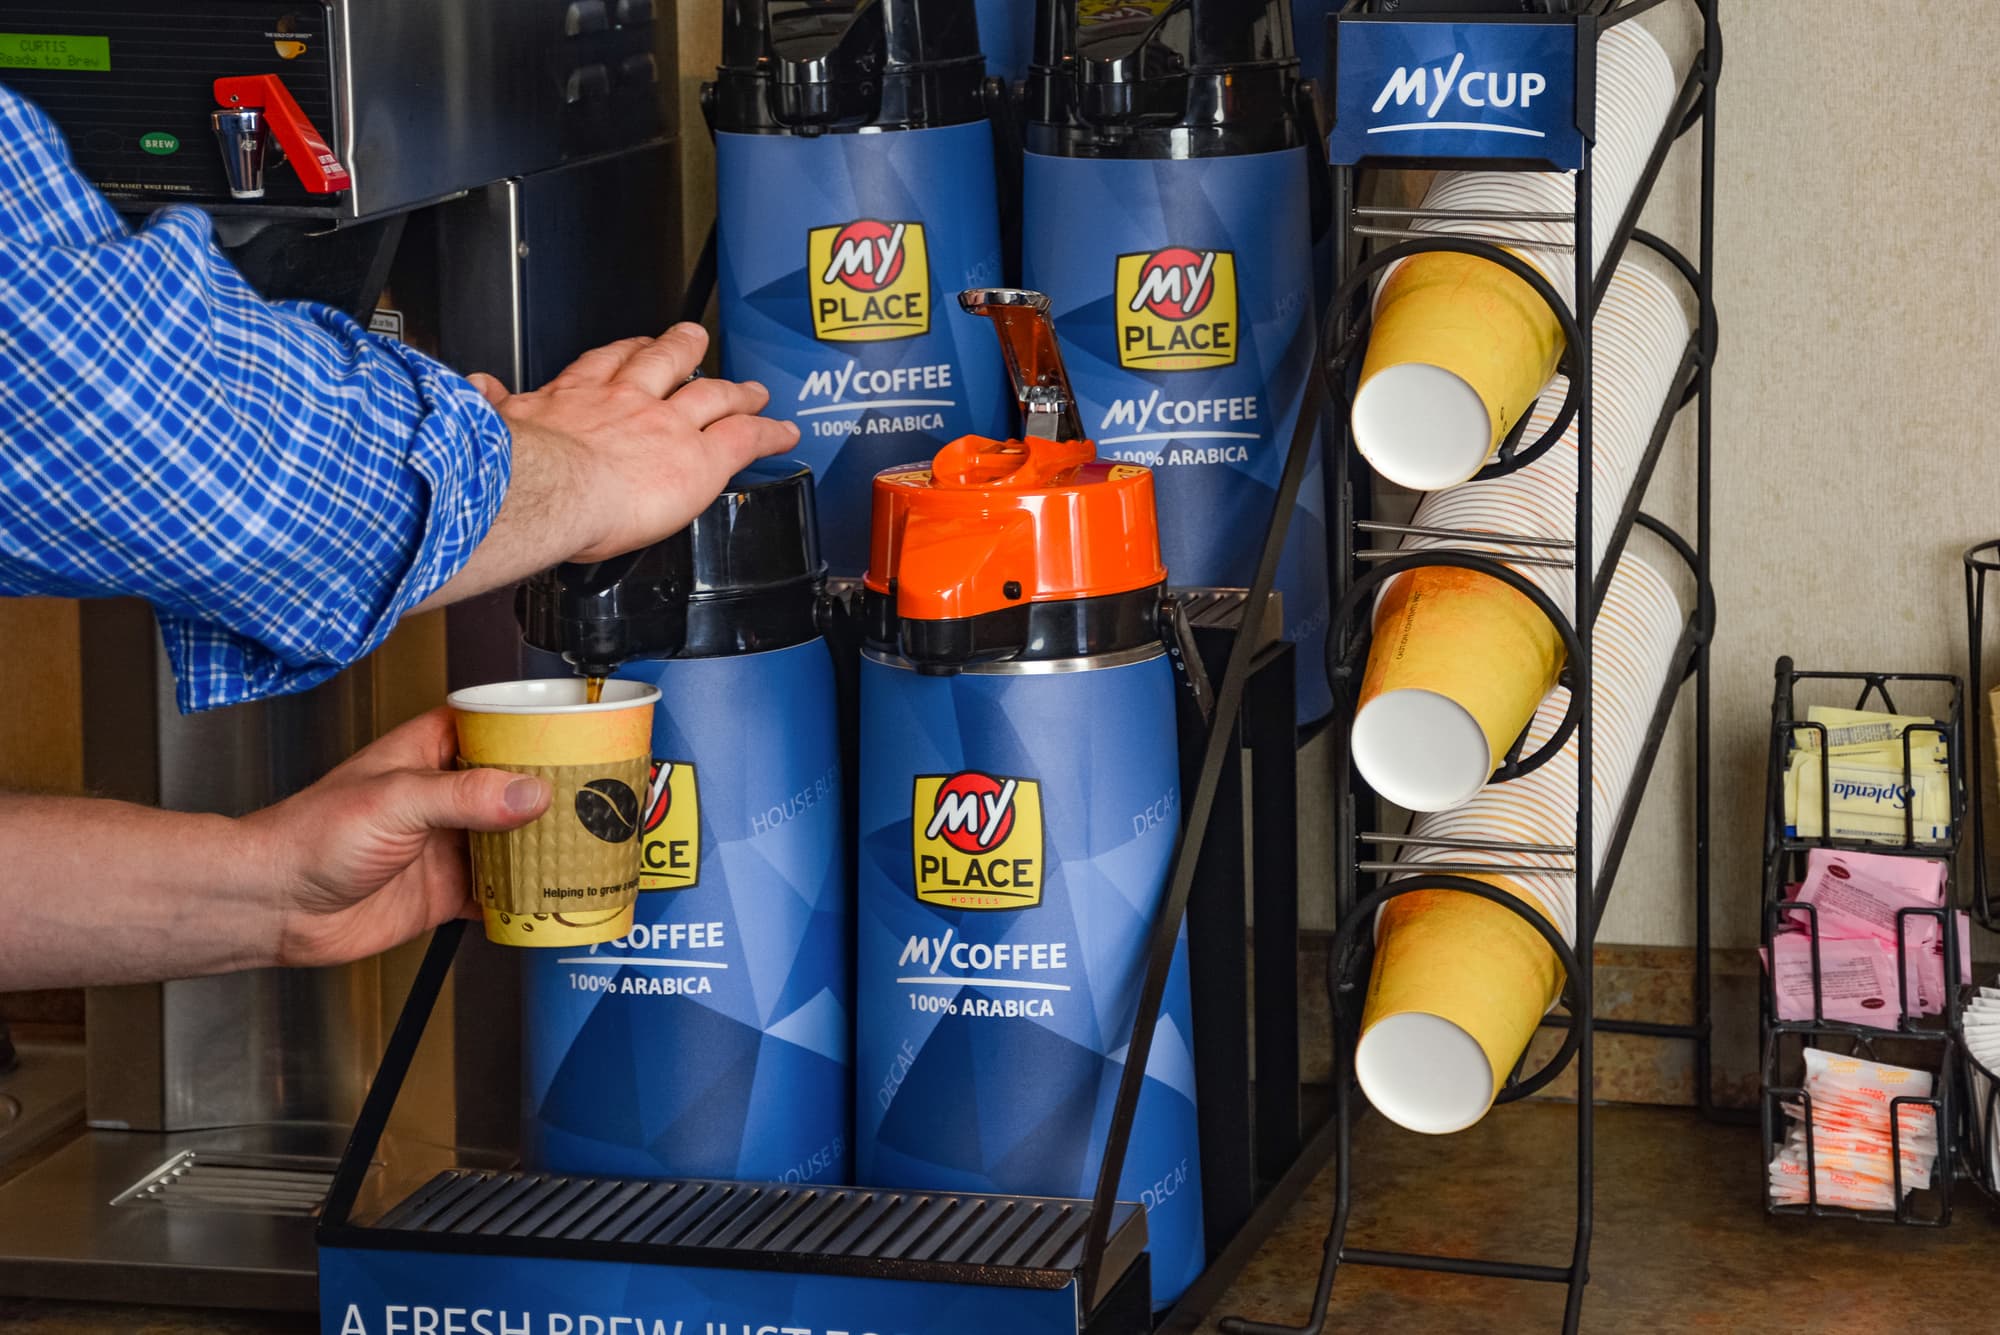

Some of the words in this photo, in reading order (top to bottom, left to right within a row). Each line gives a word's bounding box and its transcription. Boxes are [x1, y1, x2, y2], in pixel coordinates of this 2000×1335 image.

[21, 40, 67, 53] CURTIS
[46, 54, 61, 67] to
[68, 54, 100, 68] Brew
[145, 139, 175, 149] BREW
[819, 293, 923, 323] PLACE
[1125, 322, 1231, 351] PLACE
[812, 419, 862, 437] 100%
[865, 413, 944, 435] ARABICA
[1113, 450, 1164, 466] 100%
[1168, 446, 1248, 466] ARABICA
[1833, 783, 1916, 809] Splenda
[752, 787, 815, 836] HOUSE
[1133, 788, 1176, 839] DECAF
[919, 854, 1034, 887] PLACE
[543, 887, 584, 900] Helping
[587, 887, 598, 897] to
[600, 885, 620, 896] grow
[951, 895, 1001, 905] HOTELS
[569, 973, 617, 993] 100%
[620, 976, 712, 995] ARABICA
[909, 993, 958, 1016] 100%
[961, 999, 1055, 1018] ARABICA
[878, 1039, 916, 1111] DECAF
[1140, 1158, 1188, 1213] DECAF
[341, 1304, 367, 1335] A
[386, 1305, 530, 1335] FRESH
